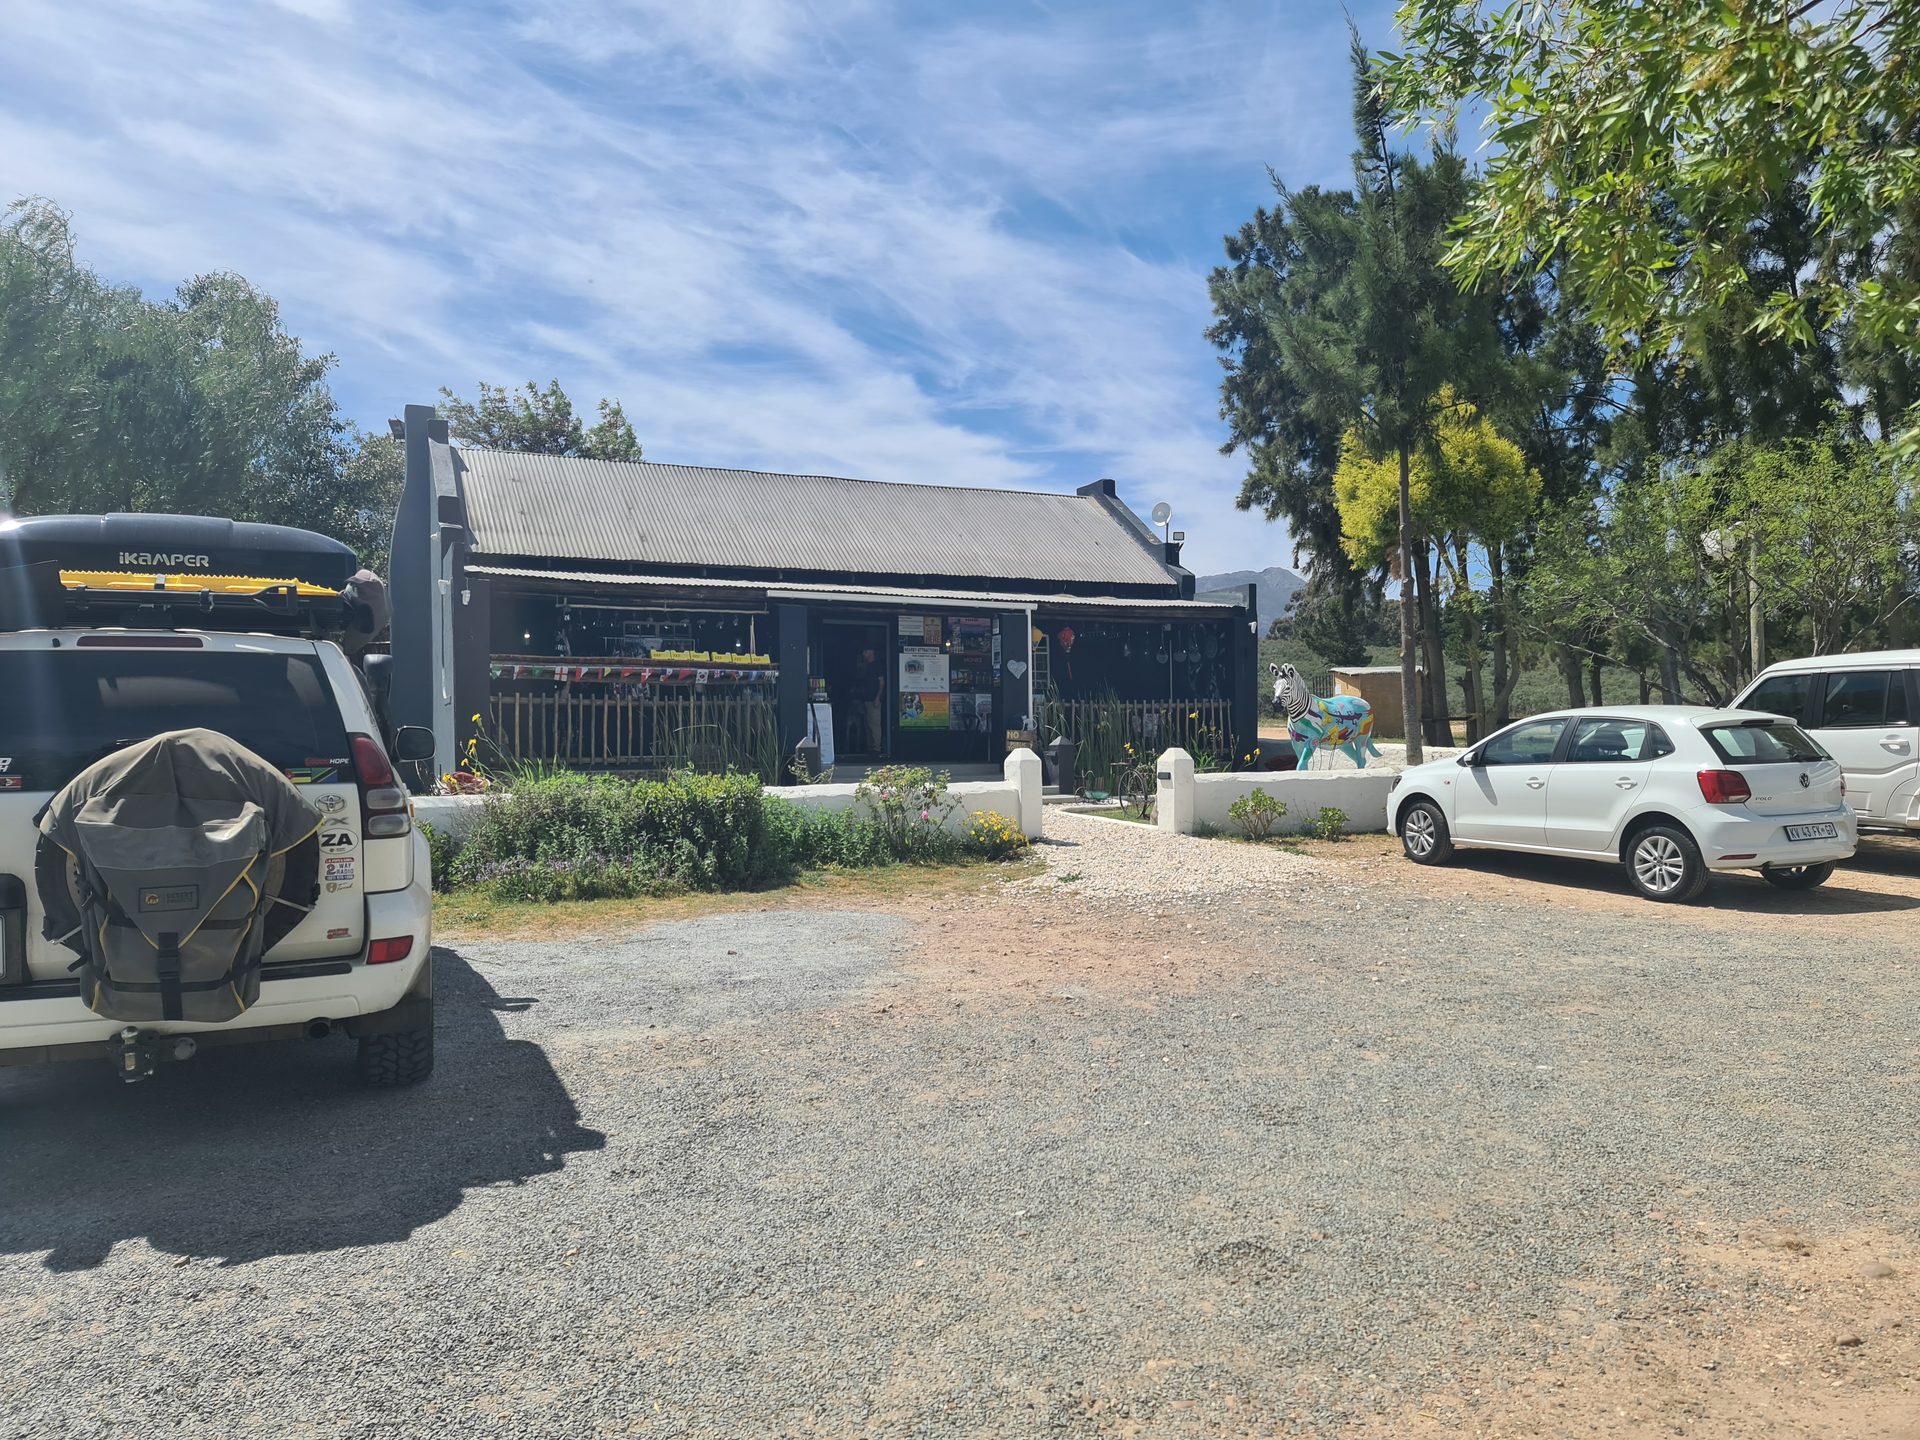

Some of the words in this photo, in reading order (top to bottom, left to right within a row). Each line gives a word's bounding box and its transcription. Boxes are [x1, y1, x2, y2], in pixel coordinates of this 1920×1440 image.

[1007, 731, 1020, 739] NO
[1789, 827, 1800, 839] KV
[1801, 826, 1811, 837] 43
[1812, 825, 1822, 837] FK
[321, 833, 353, 847] ZA
[326, 864, 336, 875] 2
